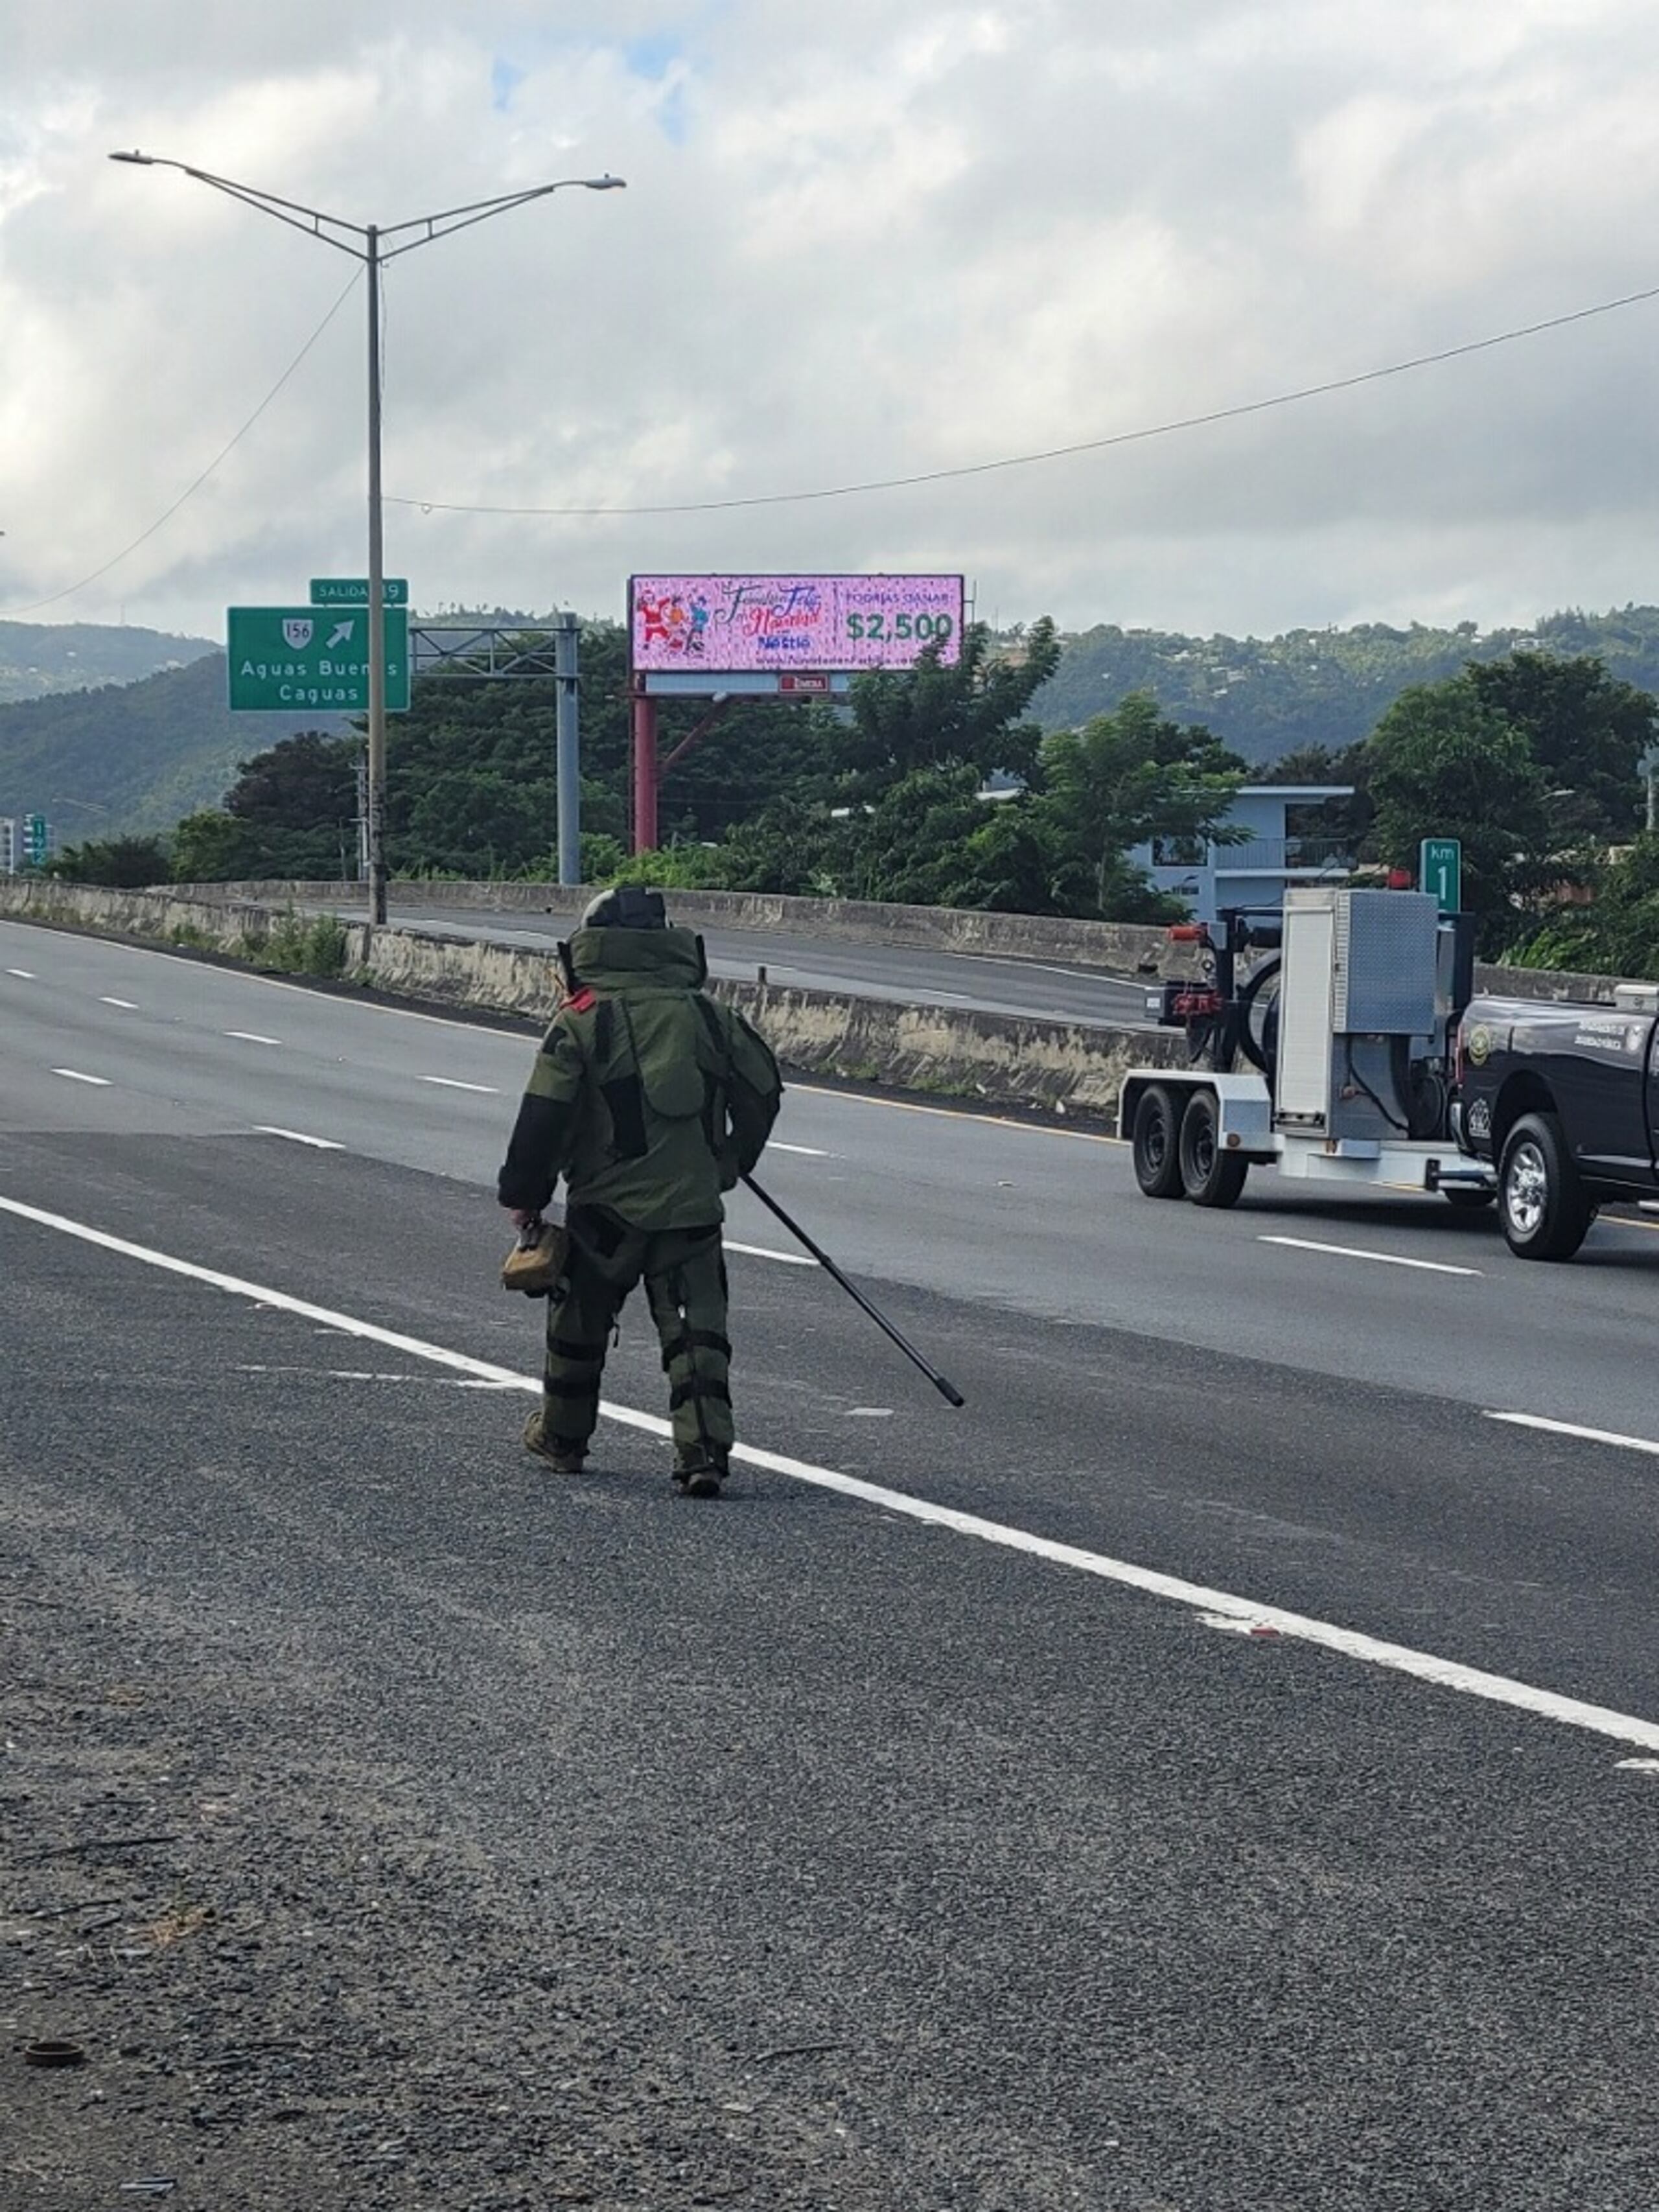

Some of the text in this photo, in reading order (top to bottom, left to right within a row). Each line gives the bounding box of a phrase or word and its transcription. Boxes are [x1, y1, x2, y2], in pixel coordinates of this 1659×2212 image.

[319, 585, 368, 597] SALIDA
[286, 623, 309, 638] 156
[846, 612, 953, 643] $2,500
[240, 661, 397, 679] Aguas Buens
[280, 684, 358, 704] Caguas
[1431, 844, 1454, 859] km
[1437, 866, 1446, 900] 1
